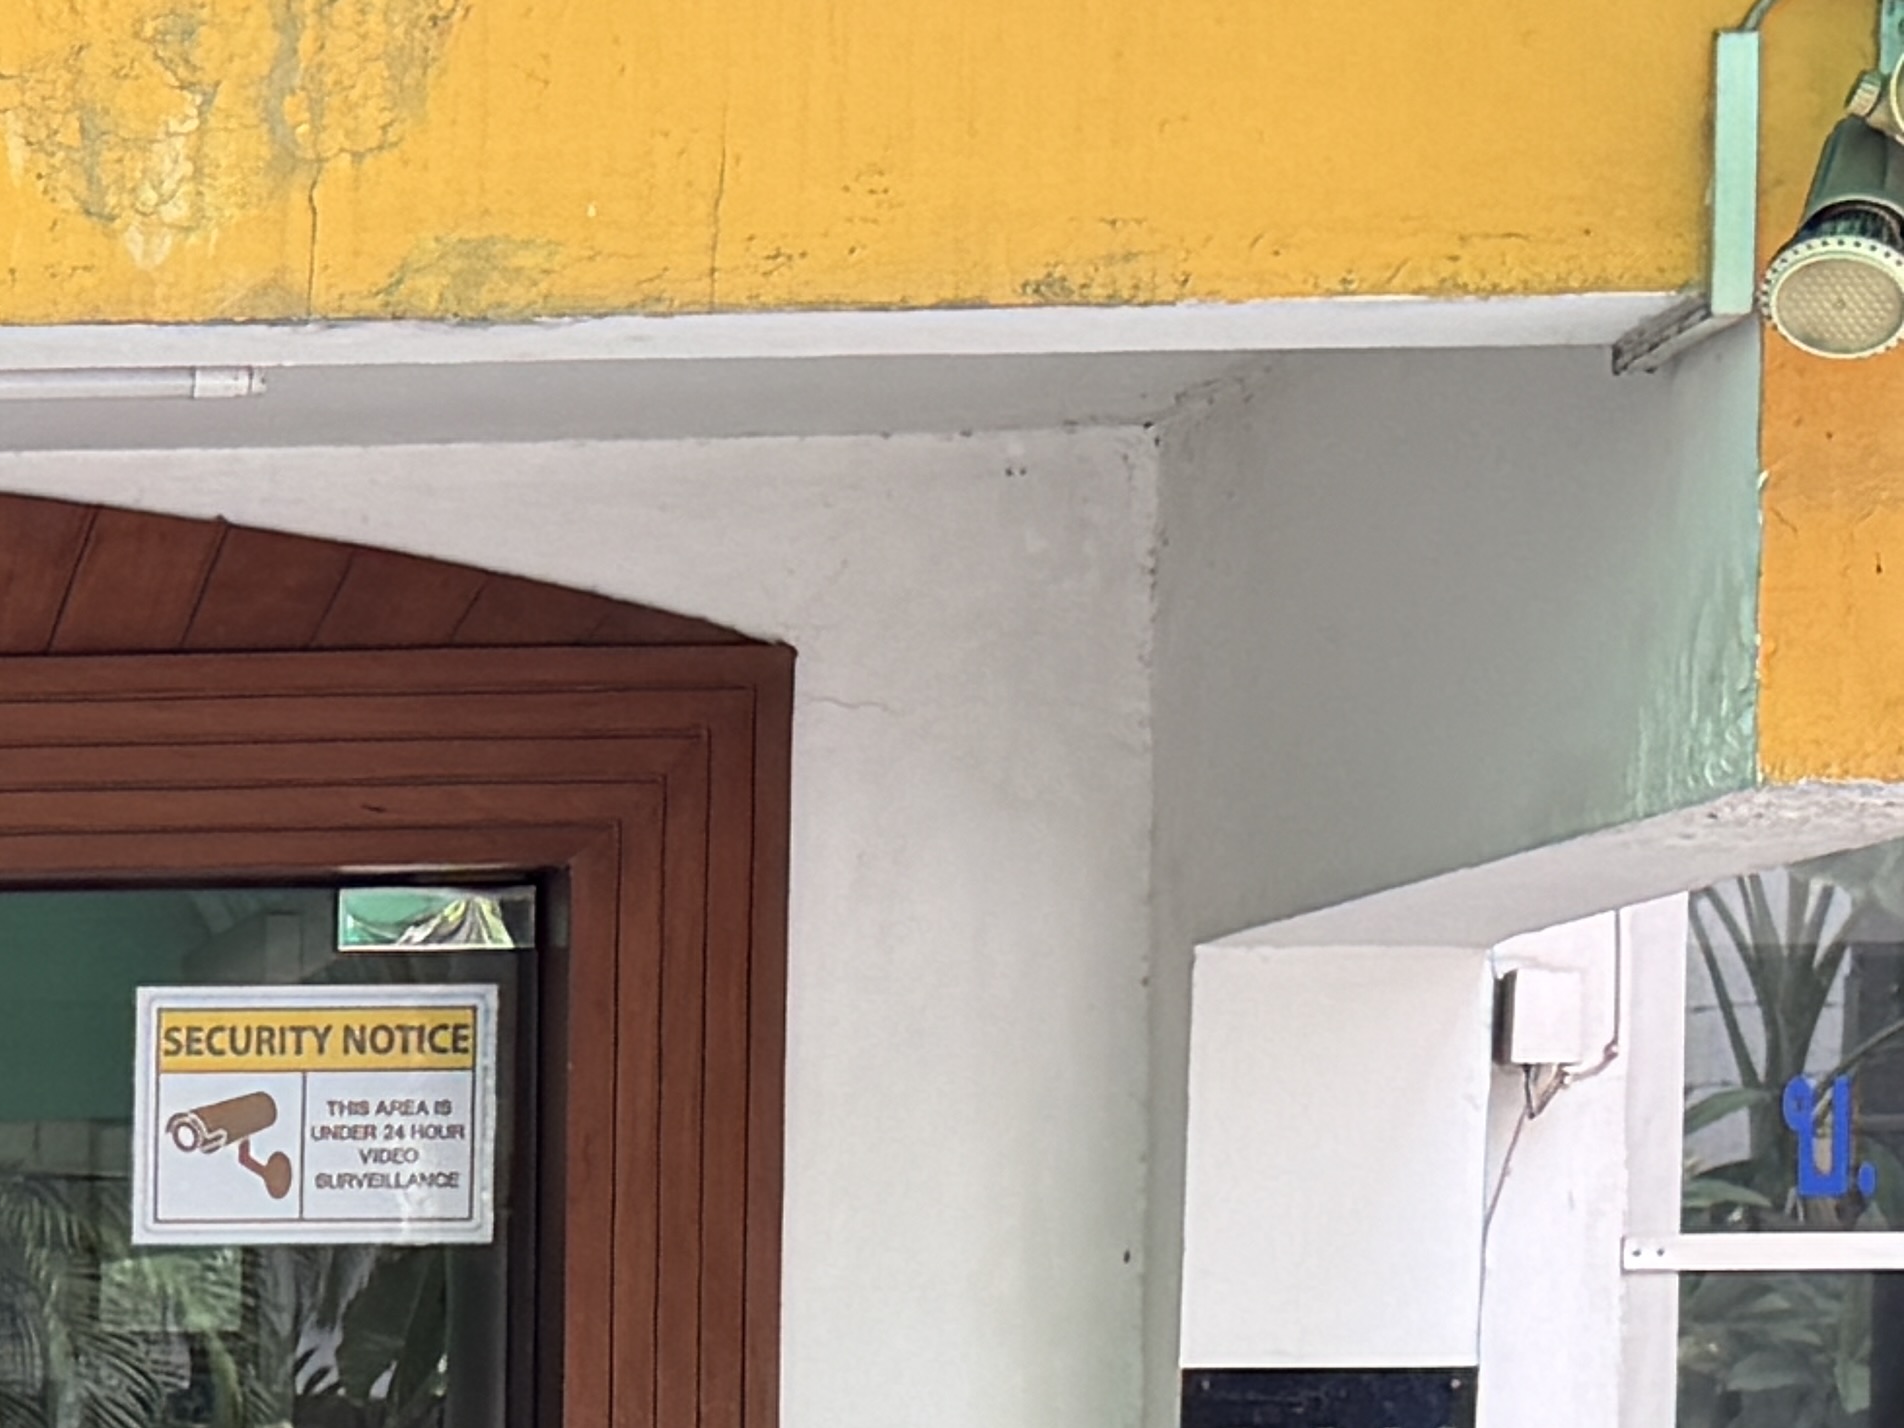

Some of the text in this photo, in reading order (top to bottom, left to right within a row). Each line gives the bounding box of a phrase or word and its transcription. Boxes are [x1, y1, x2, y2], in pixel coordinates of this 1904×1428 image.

[163, 1023, 470, 1057] SECURITY NOTICE
[327, 1099, 453, 1116] THIS AREA IS
[310, 1124, 465, 1141] UNDER 24 HOUR
[358, 1147, 420, 1164] VIDEO
[314, 1171, 461, 1189] SURVEILLANCE
